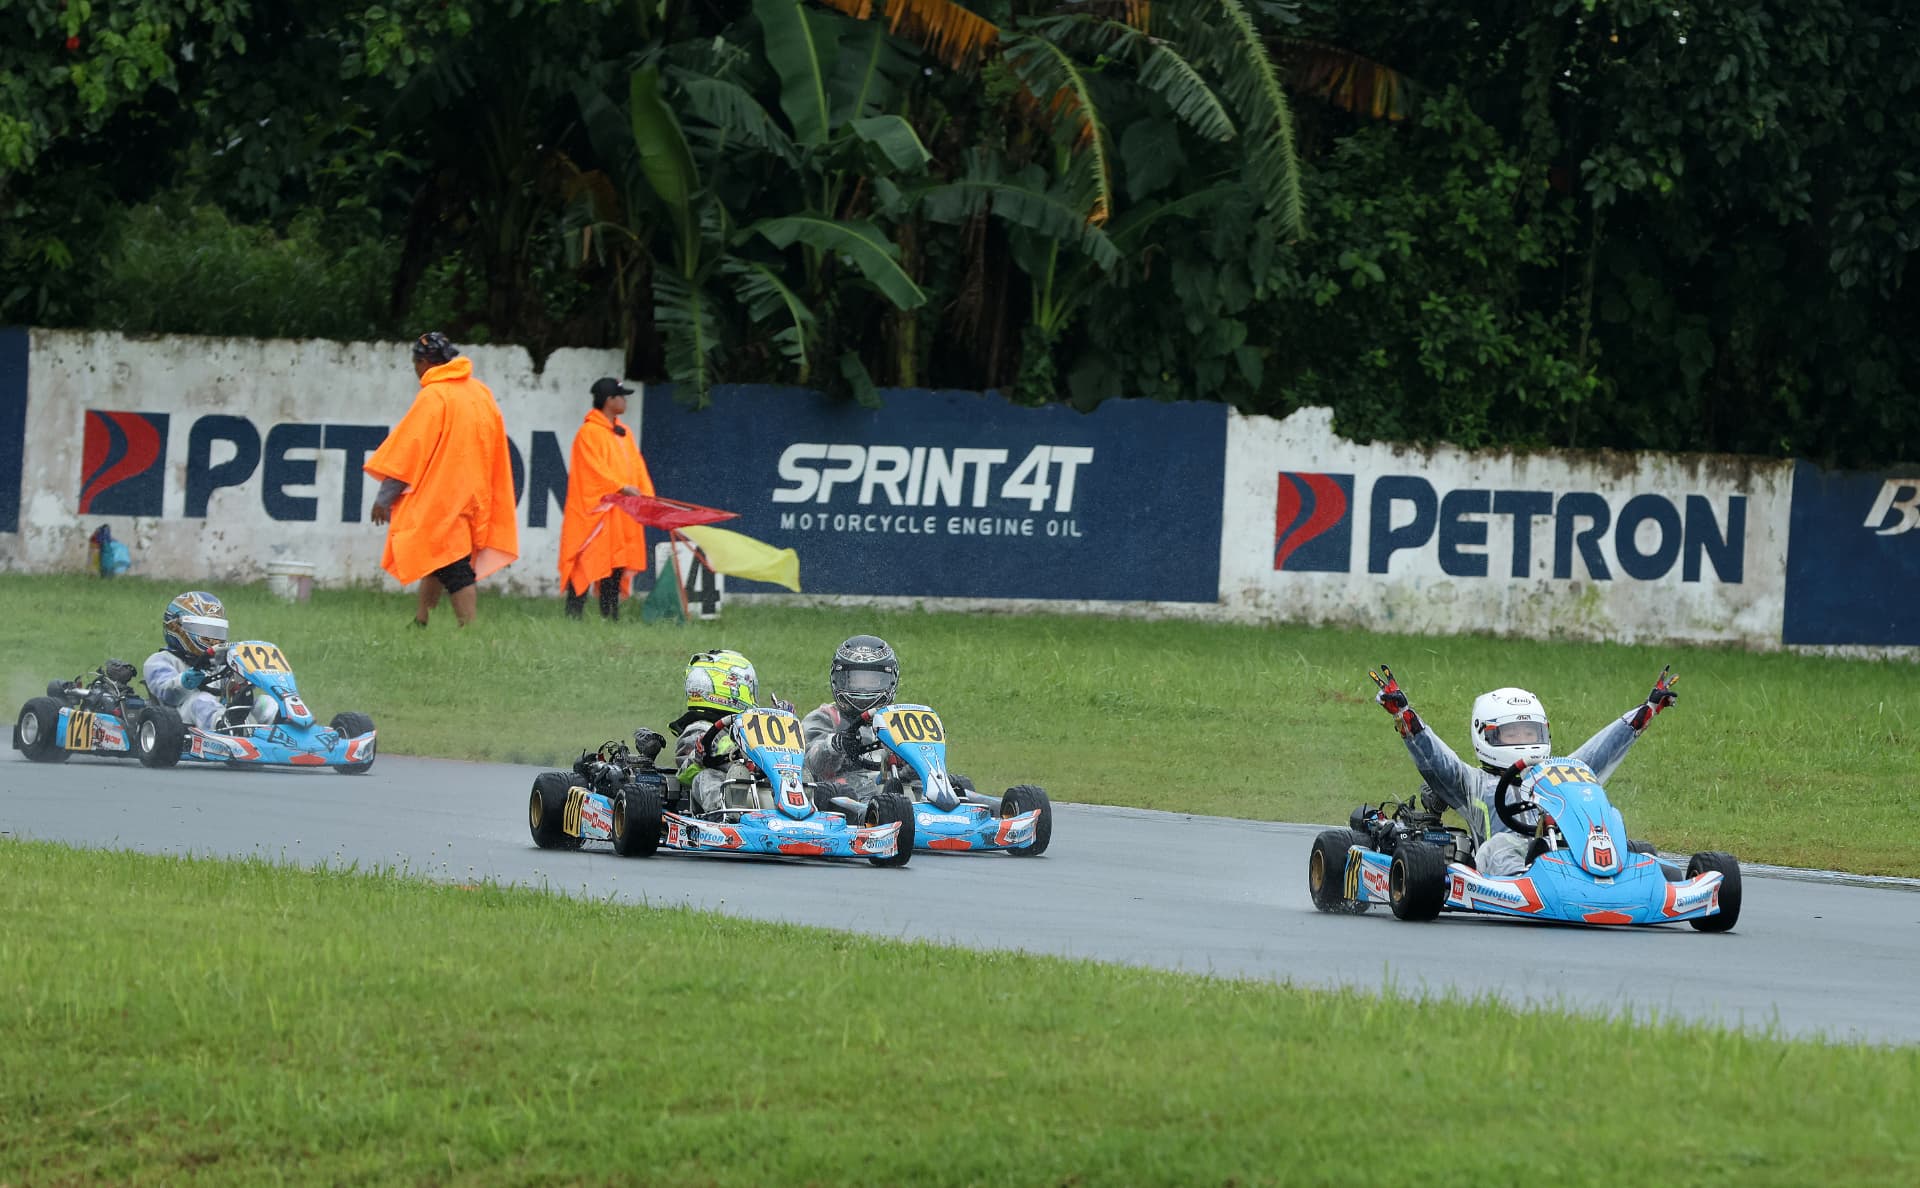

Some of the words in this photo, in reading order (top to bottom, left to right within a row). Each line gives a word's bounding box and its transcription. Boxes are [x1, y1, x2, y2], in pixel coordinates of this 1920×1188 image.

[184, 413, 569, 529] PETN
[772, 443, 1008, 508] SPRINT
[1001, 445, 1094, 512] 4T
[780, 512, 937, 534] MOTORCYCLE
[947, 516, 1034, 536] ENGINE
[1046, 519, 1082, 538] OIL
[1367, 475, 1748, 584] PETRON
[685, 545, 720, 614] 4
[242, 646, 291, 672] 121
[70, 711, 92, 748] 121
[747, 715, 805, 750] 101
[889, 712, 943, 741] 109
